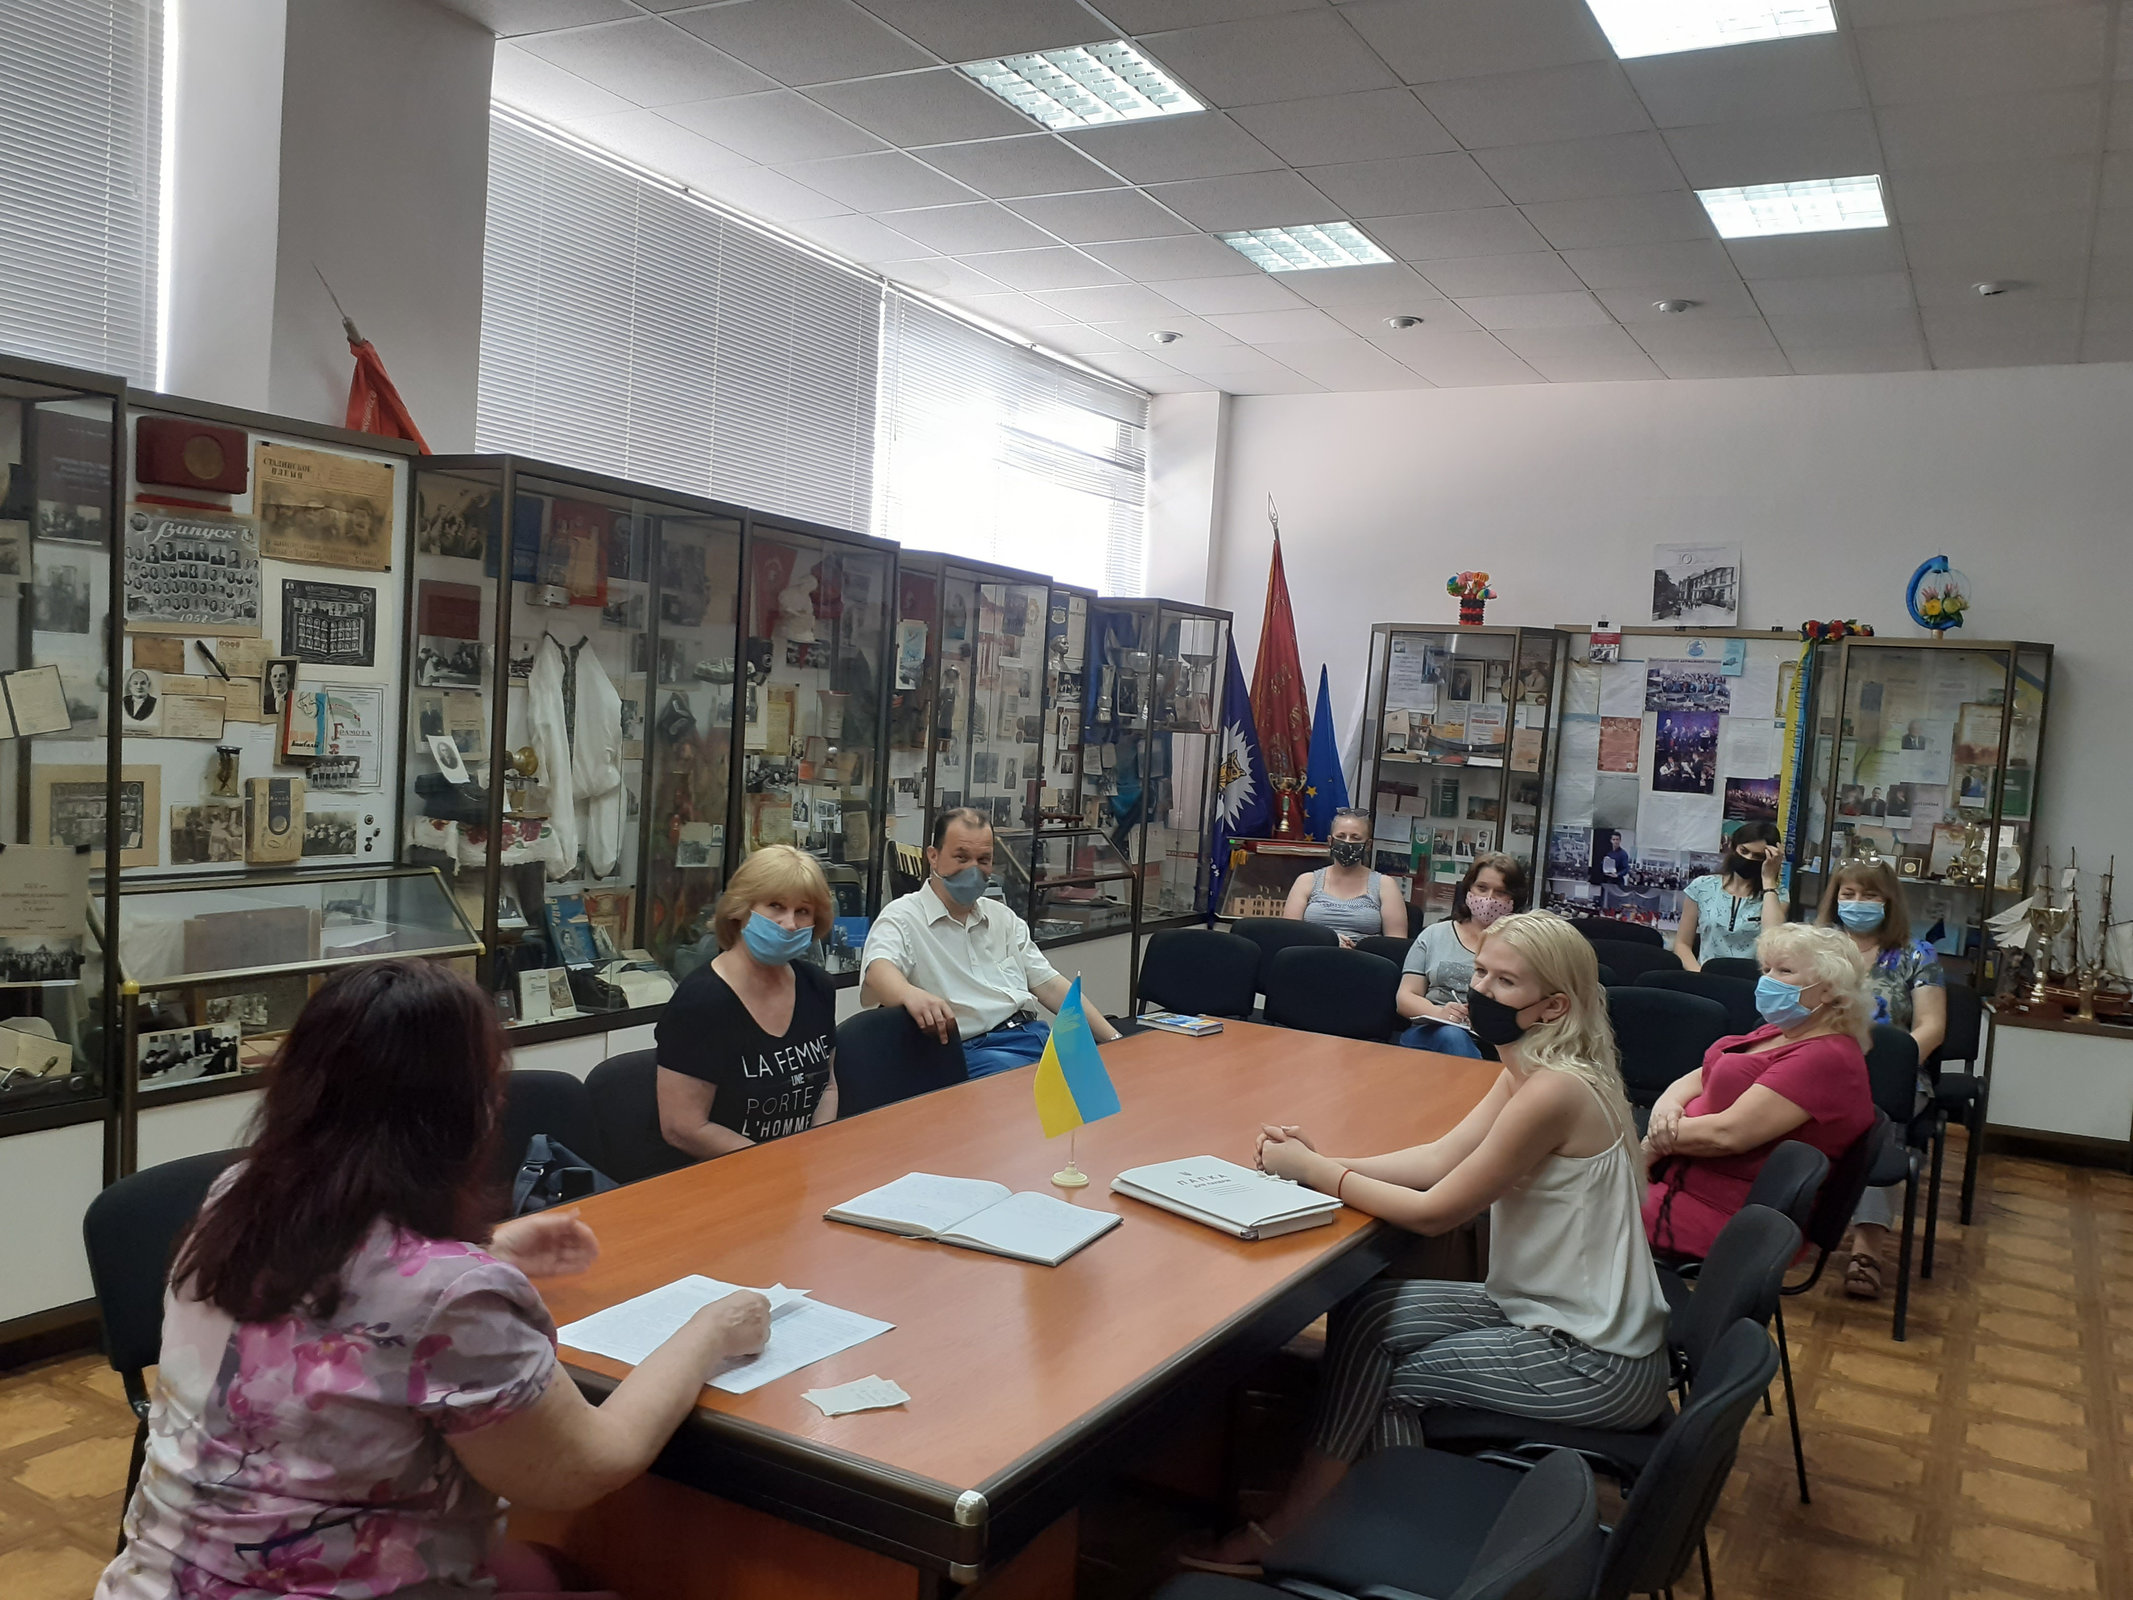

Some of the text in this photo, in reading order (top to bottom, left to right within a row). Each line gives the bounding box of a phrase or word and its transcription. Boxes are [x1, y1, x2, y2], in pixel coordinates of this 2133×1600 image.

[742, 1035, 830, 1077] LA FEMME
[791, 1073, 805, 1086] UNE
[747, 1086, 814, 1115] PORTE
